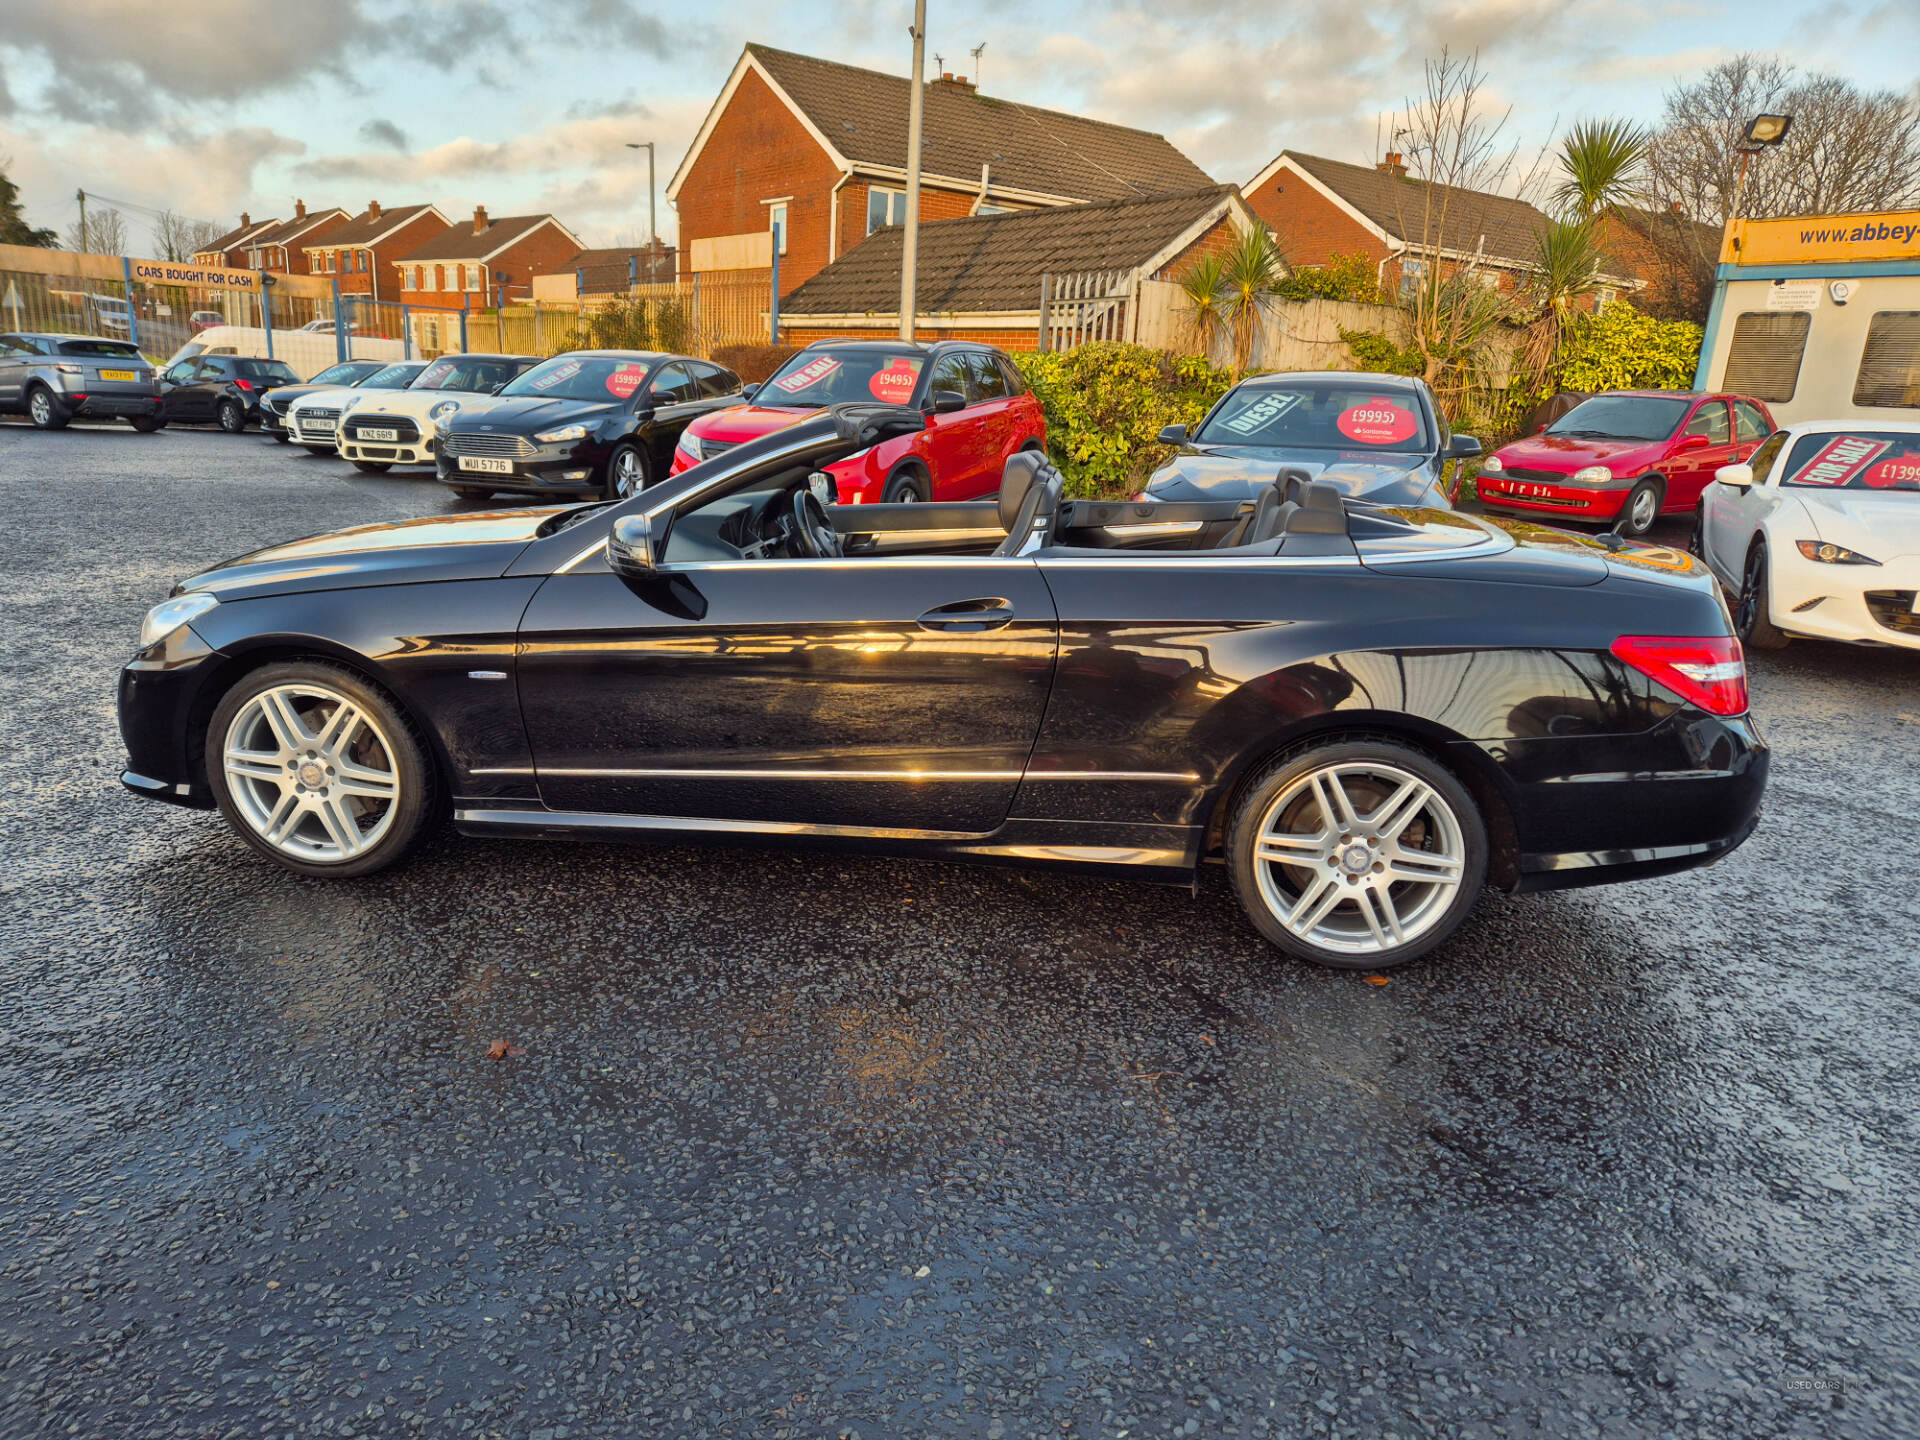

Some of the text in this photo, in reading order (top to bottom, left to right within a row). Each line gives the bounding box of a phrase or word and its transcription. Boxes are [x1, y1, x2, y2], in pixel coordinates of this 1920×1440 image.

[137, 266, 253, 287] CARS BOUGHT FOR CASH
[781, 356, 838, 389] FOR SALE
[1227, 393, 1295, 432] DIESEL
[481, 460, 506, 471] 5776
[1803, 439, 1877, 484] FOR SALE
